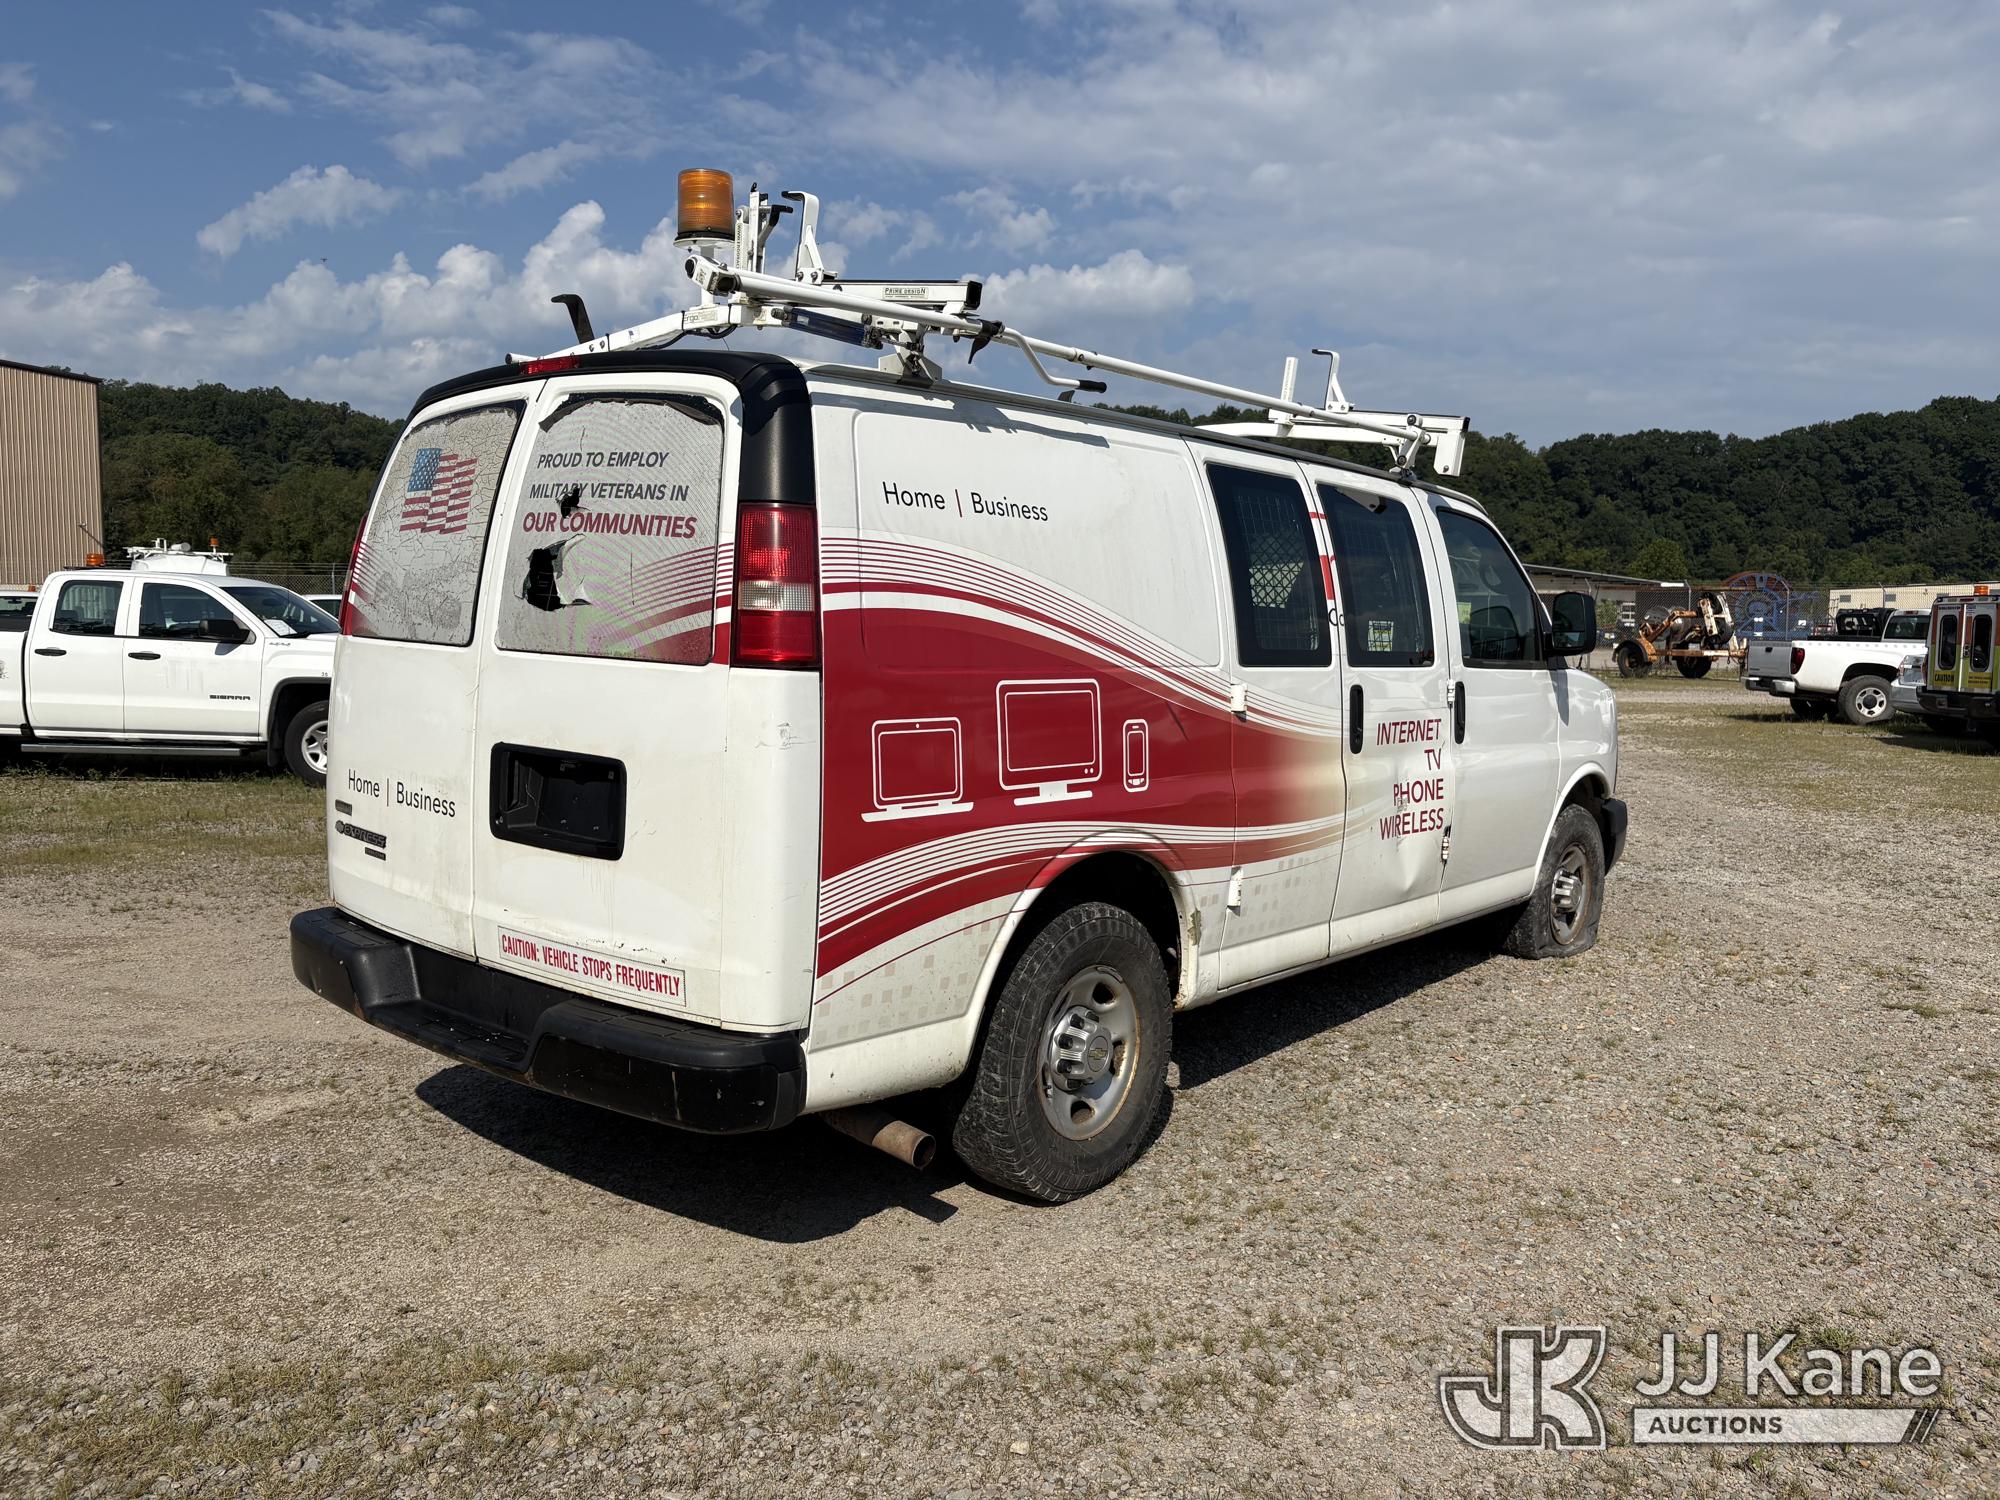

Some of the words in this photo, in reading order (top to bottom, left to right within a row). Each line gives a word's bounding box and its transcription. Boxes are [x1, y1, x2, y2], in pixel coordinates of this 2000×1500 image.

[537, 452, 583, 469] PROUD
[585, 452, 604, 467] TO
[607, 451, 669, 468] EMPLOY
[590, 482, 667, 501] VETERANS
[670, 484, 689, 501] IN
[882, 481, 946, 510] Home
[970, 491, 1049, 522] Business
[522, 511, 557, 532] OUR
[559, 511, 698, 539] COMMUNITIES
[1376, 718, 1442, 746] INTERNET
[1424, 747, 1442, 771] TV
[348, 769, 380, 798] Home
[396, 781, 456, 818] Business
[1393, 778, 1444, 807] PHONE
[344, 823, 387, 849] EXPRESS
[1379, 808, 1444, 841] WIRELESS
[501, 934, 540, 963] CAUTION:
[542, 946, 579, 974] VEHICLE
[582, 956, 613, 982] STOPS
[616, 964, 680, 997] FREQUENTLY
